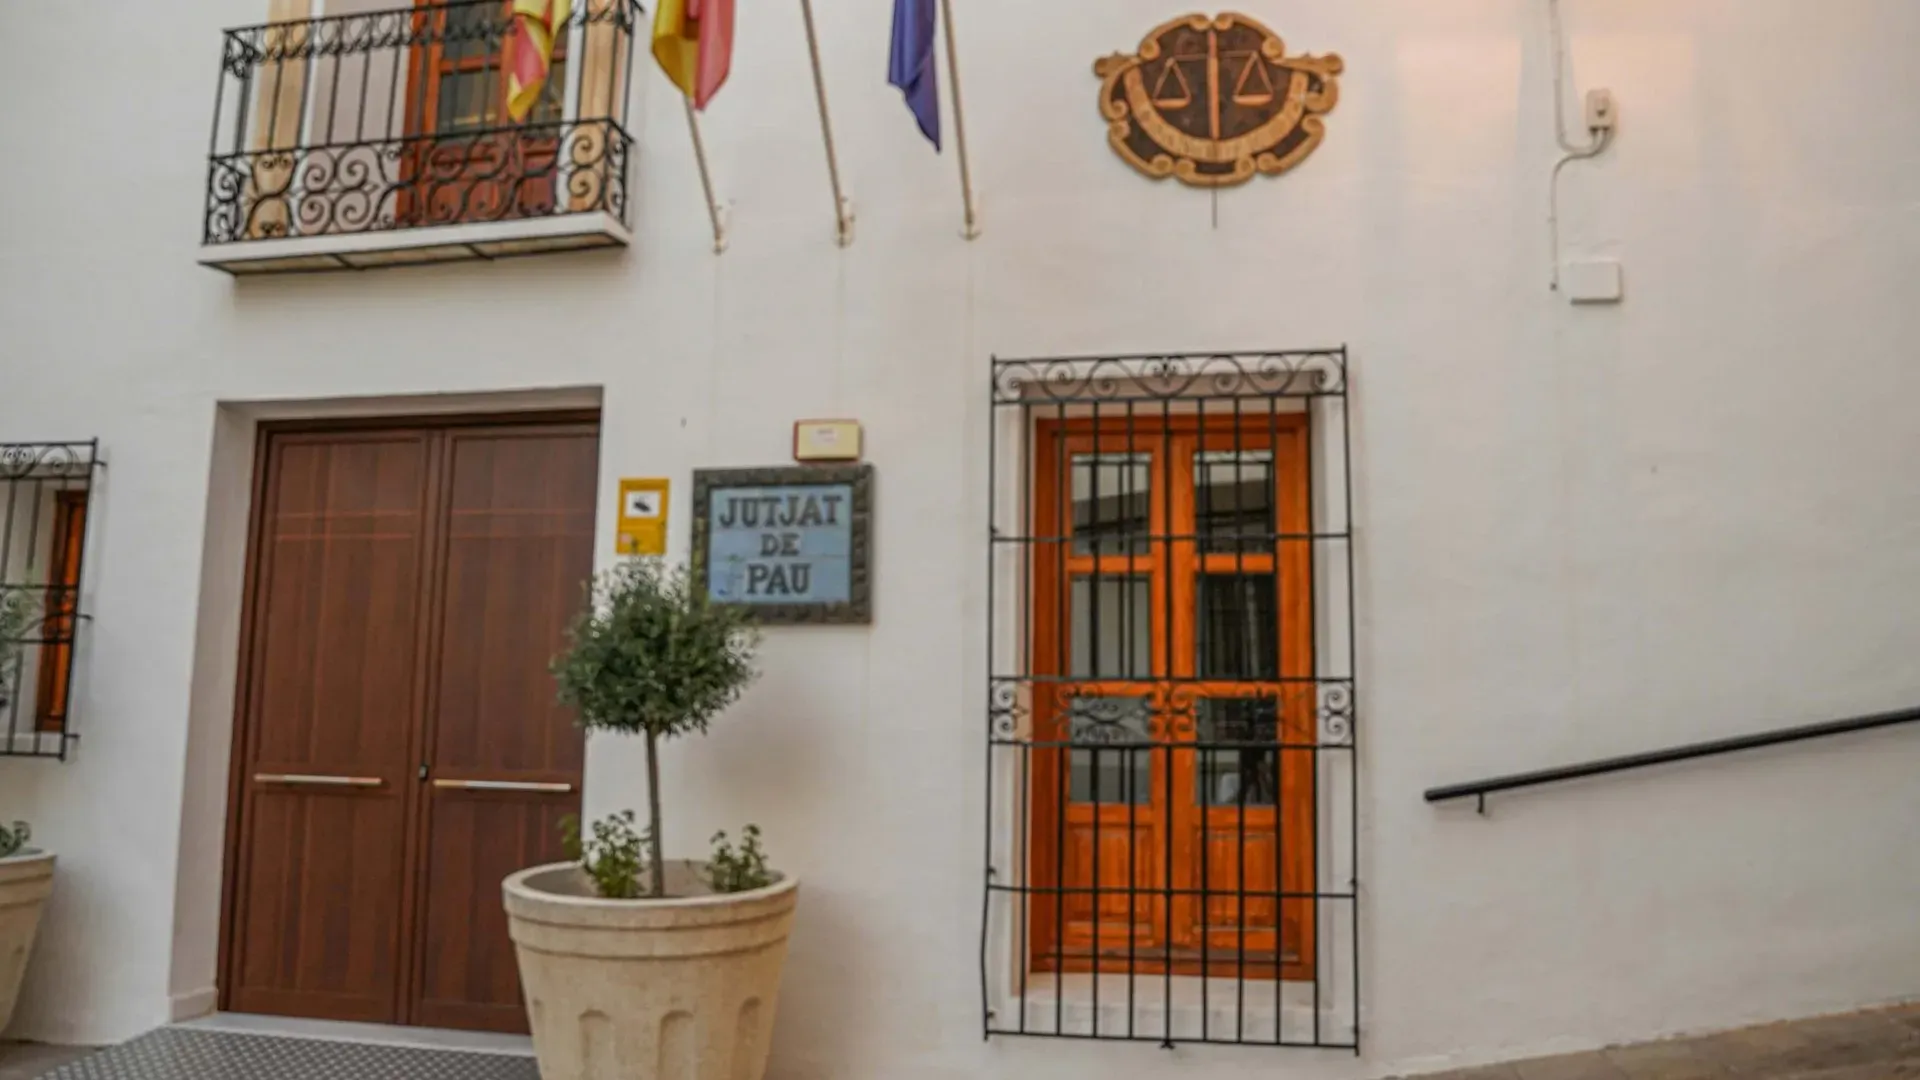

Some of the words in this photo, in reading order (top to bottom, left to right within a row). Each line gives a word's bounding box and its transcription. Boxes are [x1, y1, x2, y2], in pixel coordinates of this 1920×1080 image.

[719, 495, 842, 527] JUTJAT
[760, 533, 799, 556] DE
[747, 563, 811, 595] PAU
